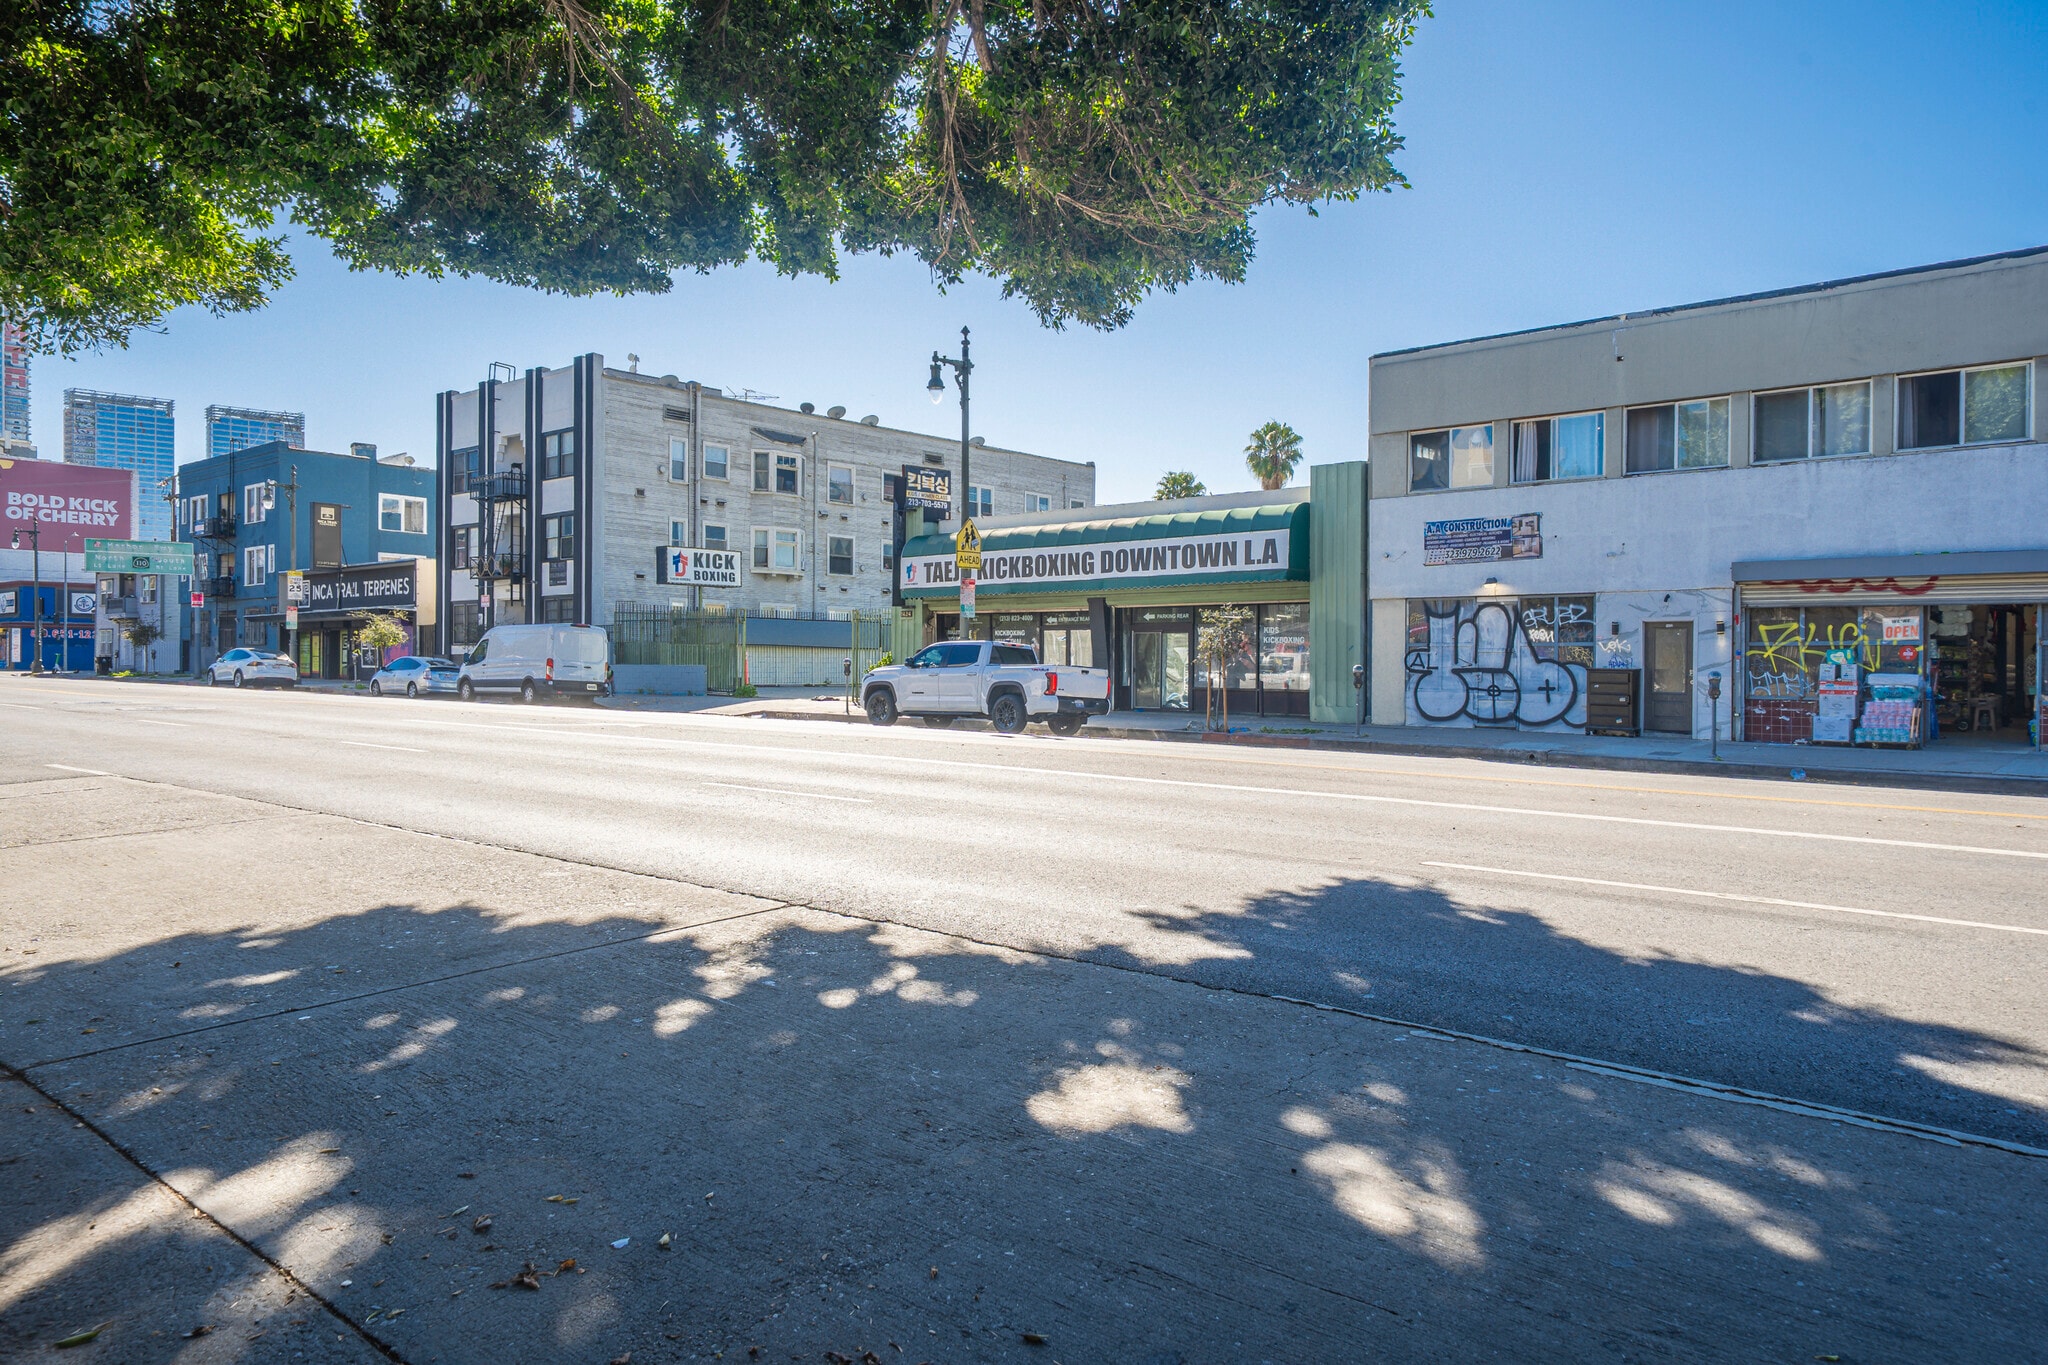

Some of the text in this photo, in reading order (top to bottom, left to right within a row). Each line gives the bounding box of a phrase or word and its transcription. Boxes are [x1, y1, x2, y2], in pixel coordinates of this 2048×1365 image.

[907, 471, 949, 494] 킥복싱
[8, 491, 118, 513] BOLD KICK
[5, 506, 119, 526] OF CHERRY
[1443, 518, 1507, 532] CONSTRUCTION
[959, 555, 980, 565] AHEAD
[1445, 547, 1501, 559] 323.979.2622
[693, 552, 735, 570] KICK
[924, 538, 1278, 583] TAEJ KICKBOXING DOWNTOWN L.A
[694, 570, 736, 582] BOXING
[289, 584, 302, 592] 25
[312, 584, 333, 600] INCA
[363, 577, 410, 597] TERPENES
[1263, 626, 1280, 634] KIDS
[1885, 624, 1919, 639] OPEN
[1263, 636, 1305, 644] KICKBOXING
